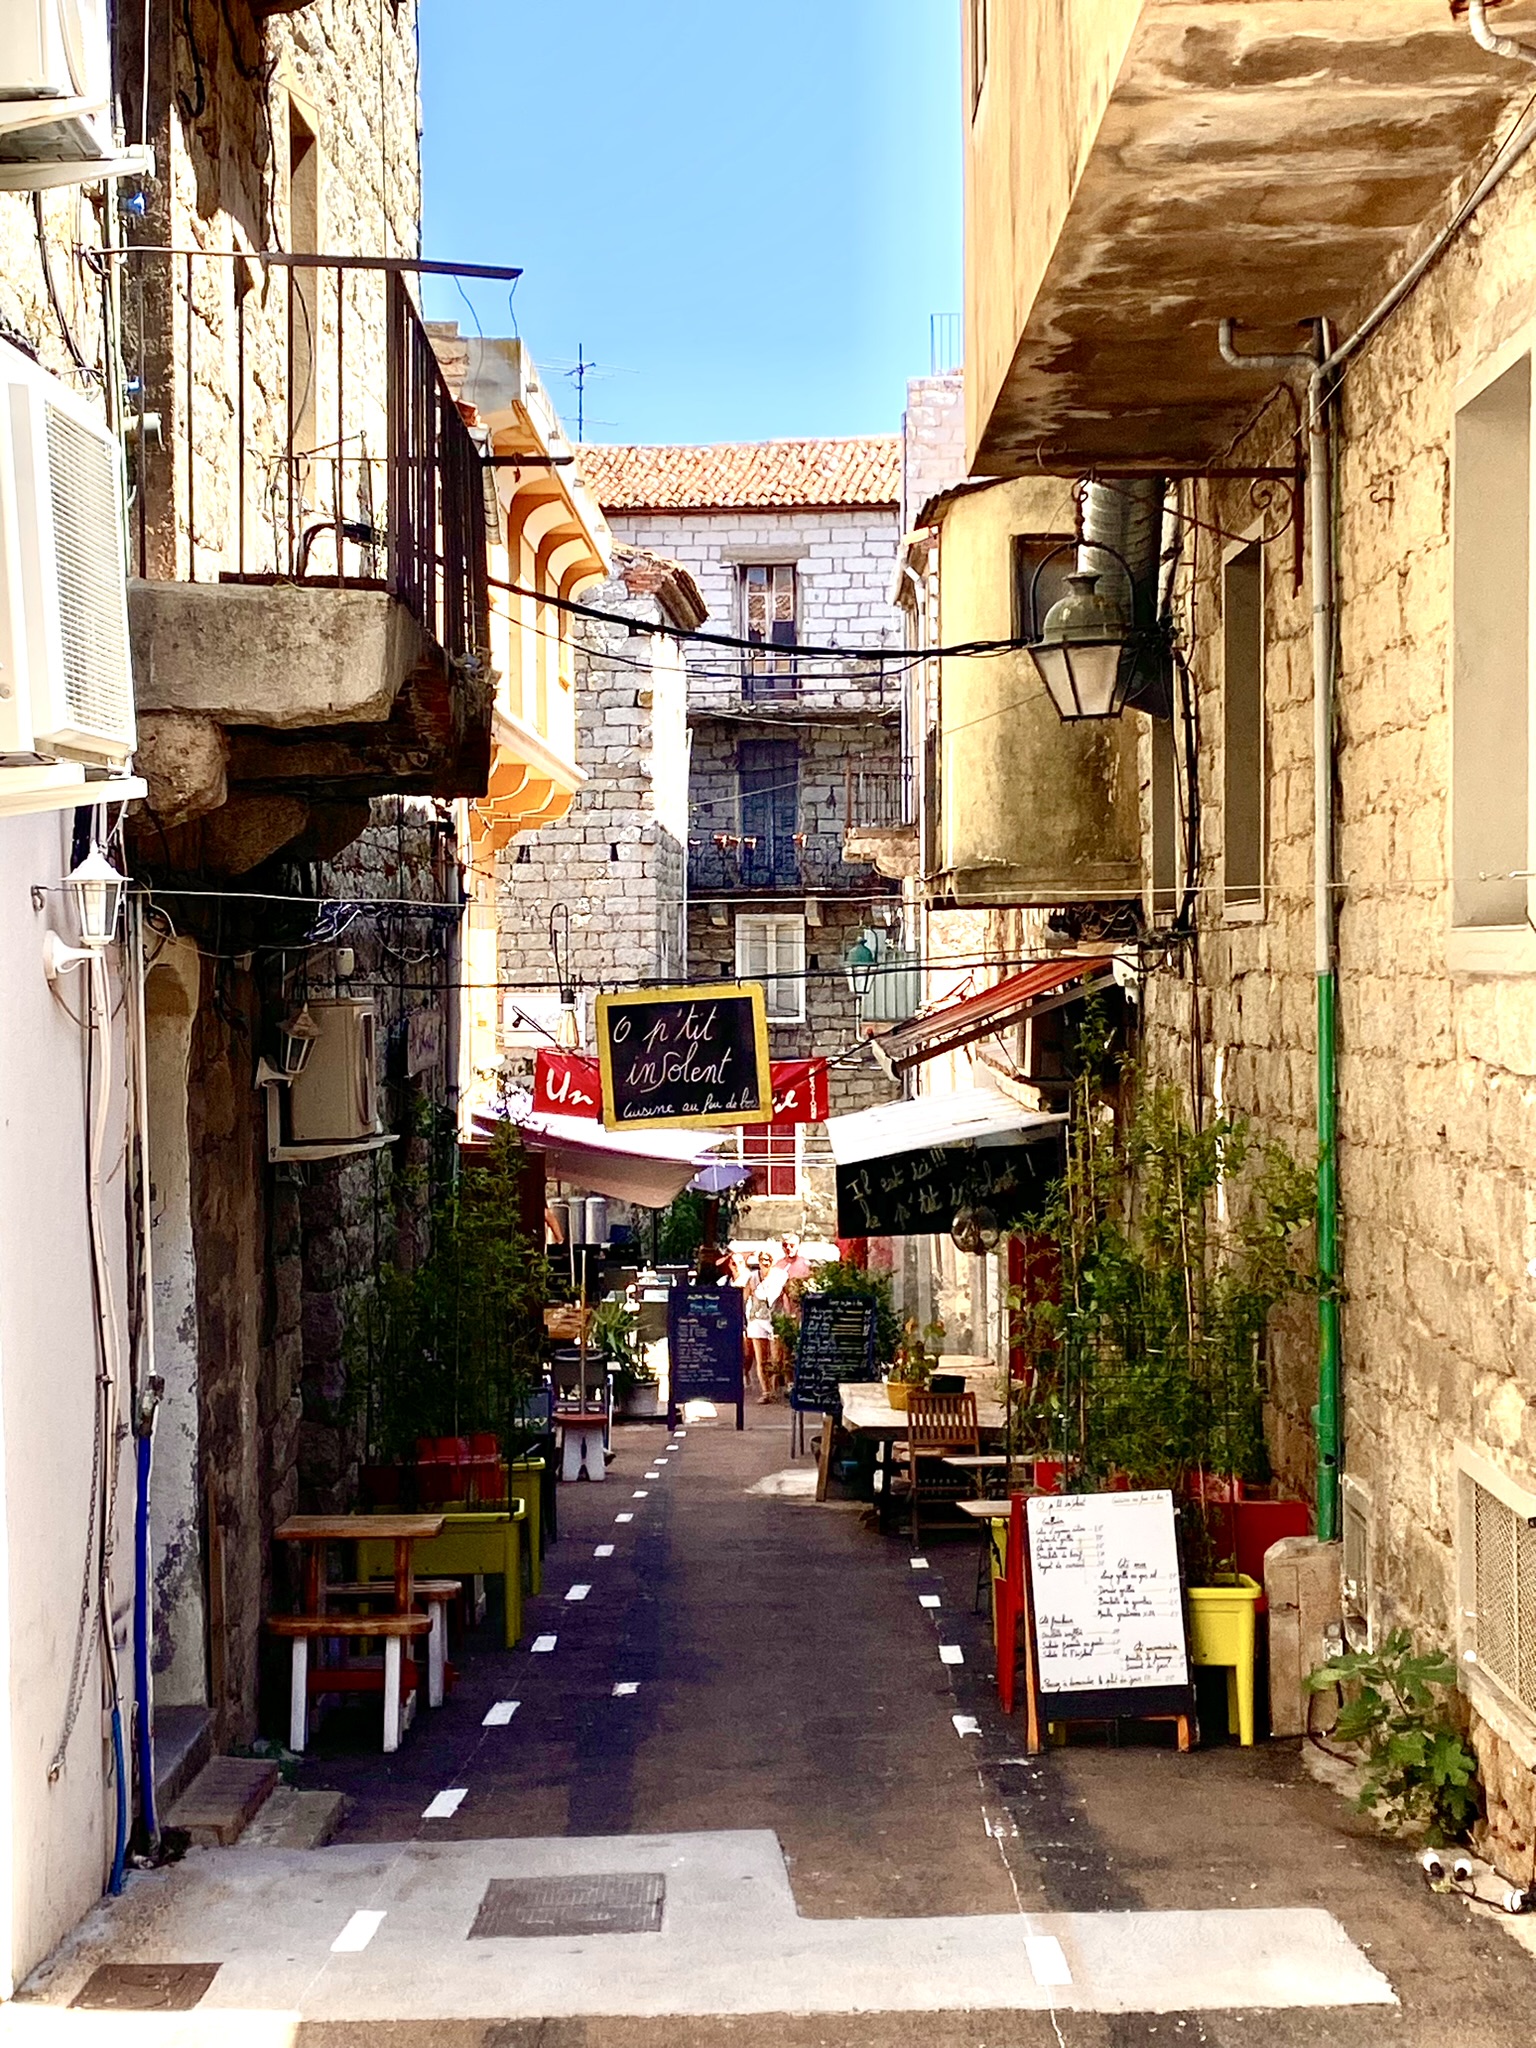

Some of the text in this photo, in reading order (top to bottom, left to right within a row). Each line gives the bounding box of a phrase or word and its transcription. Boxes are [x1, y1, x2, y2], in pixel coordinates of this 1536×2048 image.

[612, 1003, 718, 1054] O p'tit
[545, 1067, 594, 1105] Un
[622, 1100, 675, 1119] Cuisine
[682, 1101, 699, 1112] au
[701, 1092, 723, 1116] feu
[725, 1092, 738, 1110] de
